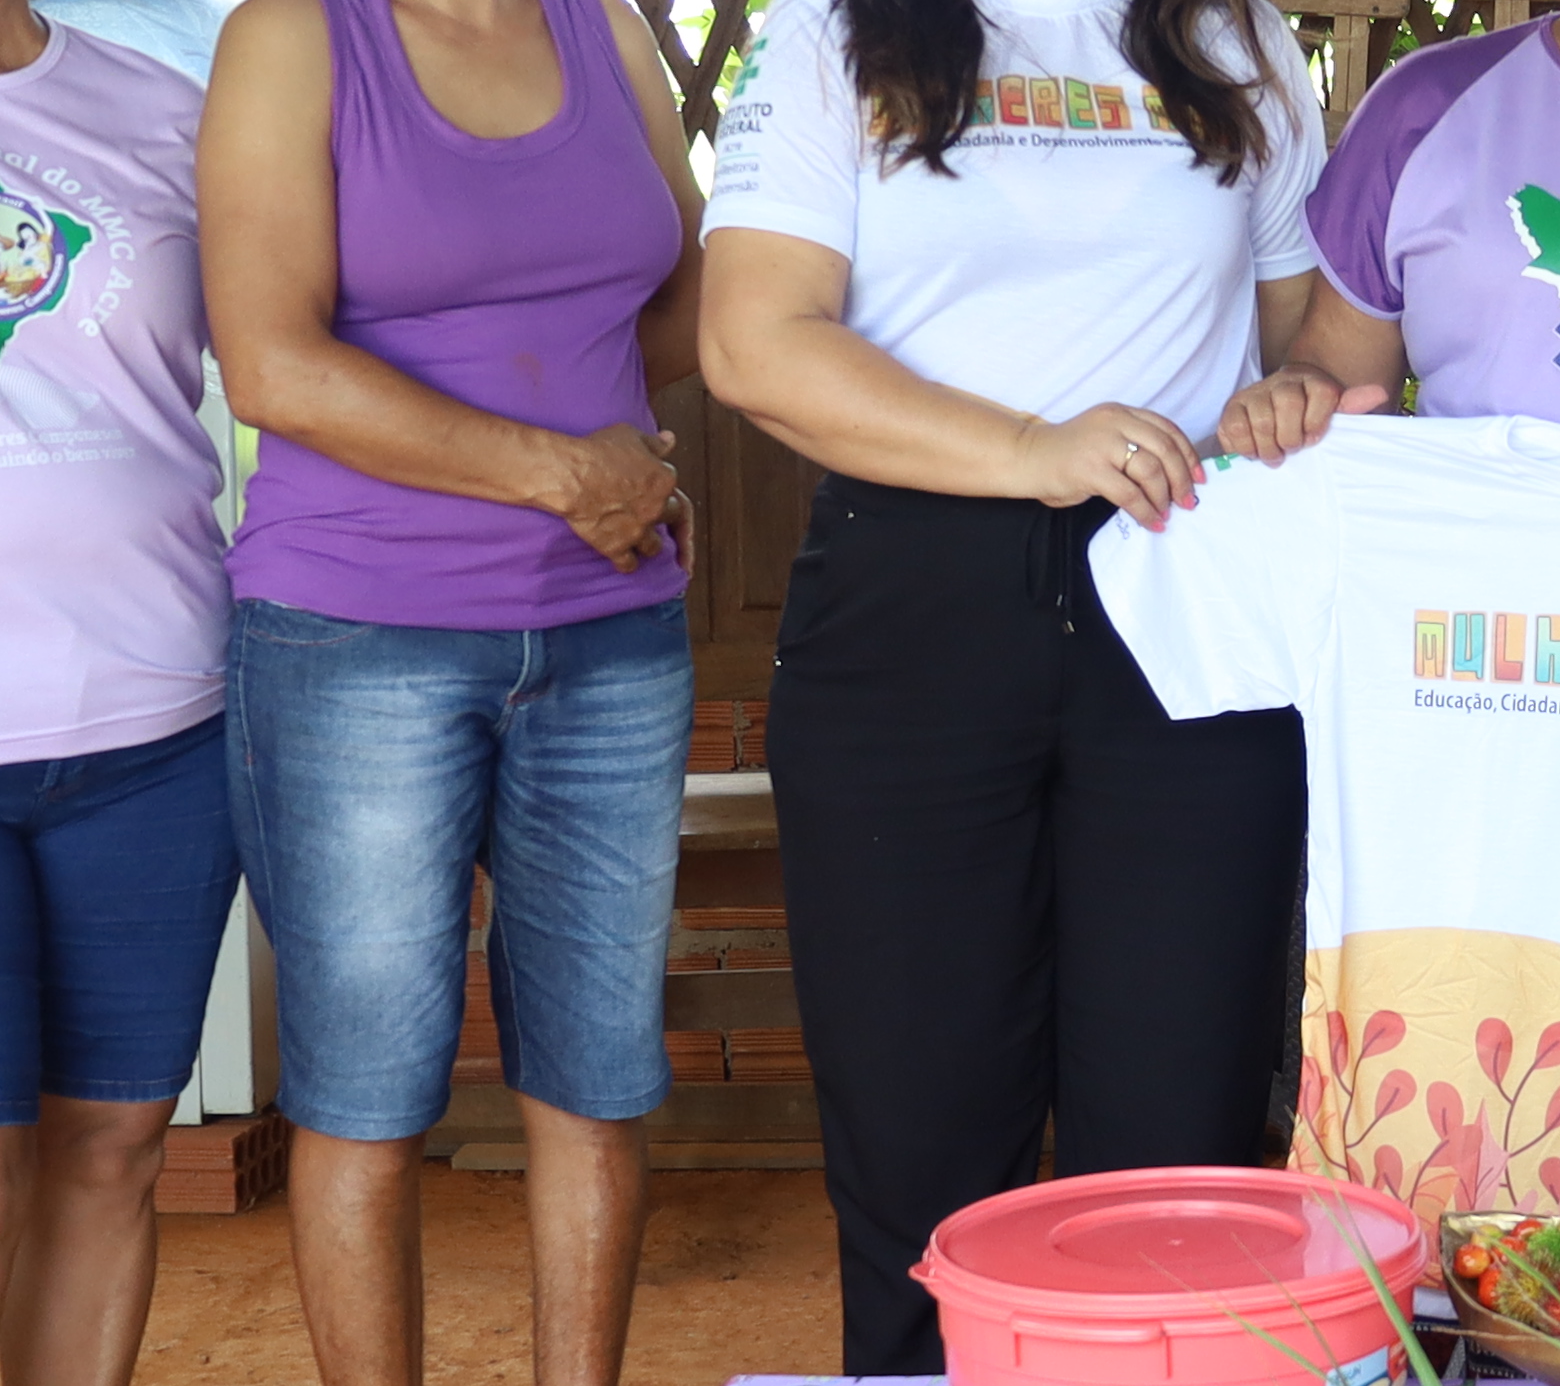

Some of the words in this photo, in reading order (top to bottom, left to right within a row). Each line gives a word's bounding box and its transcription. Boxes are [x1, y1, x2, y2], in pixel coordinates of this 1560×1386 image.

[42, 167, 82, 195] do
[79, 190, 137, 262] MMC
[1414, 689, 1497, 715] Educação,
